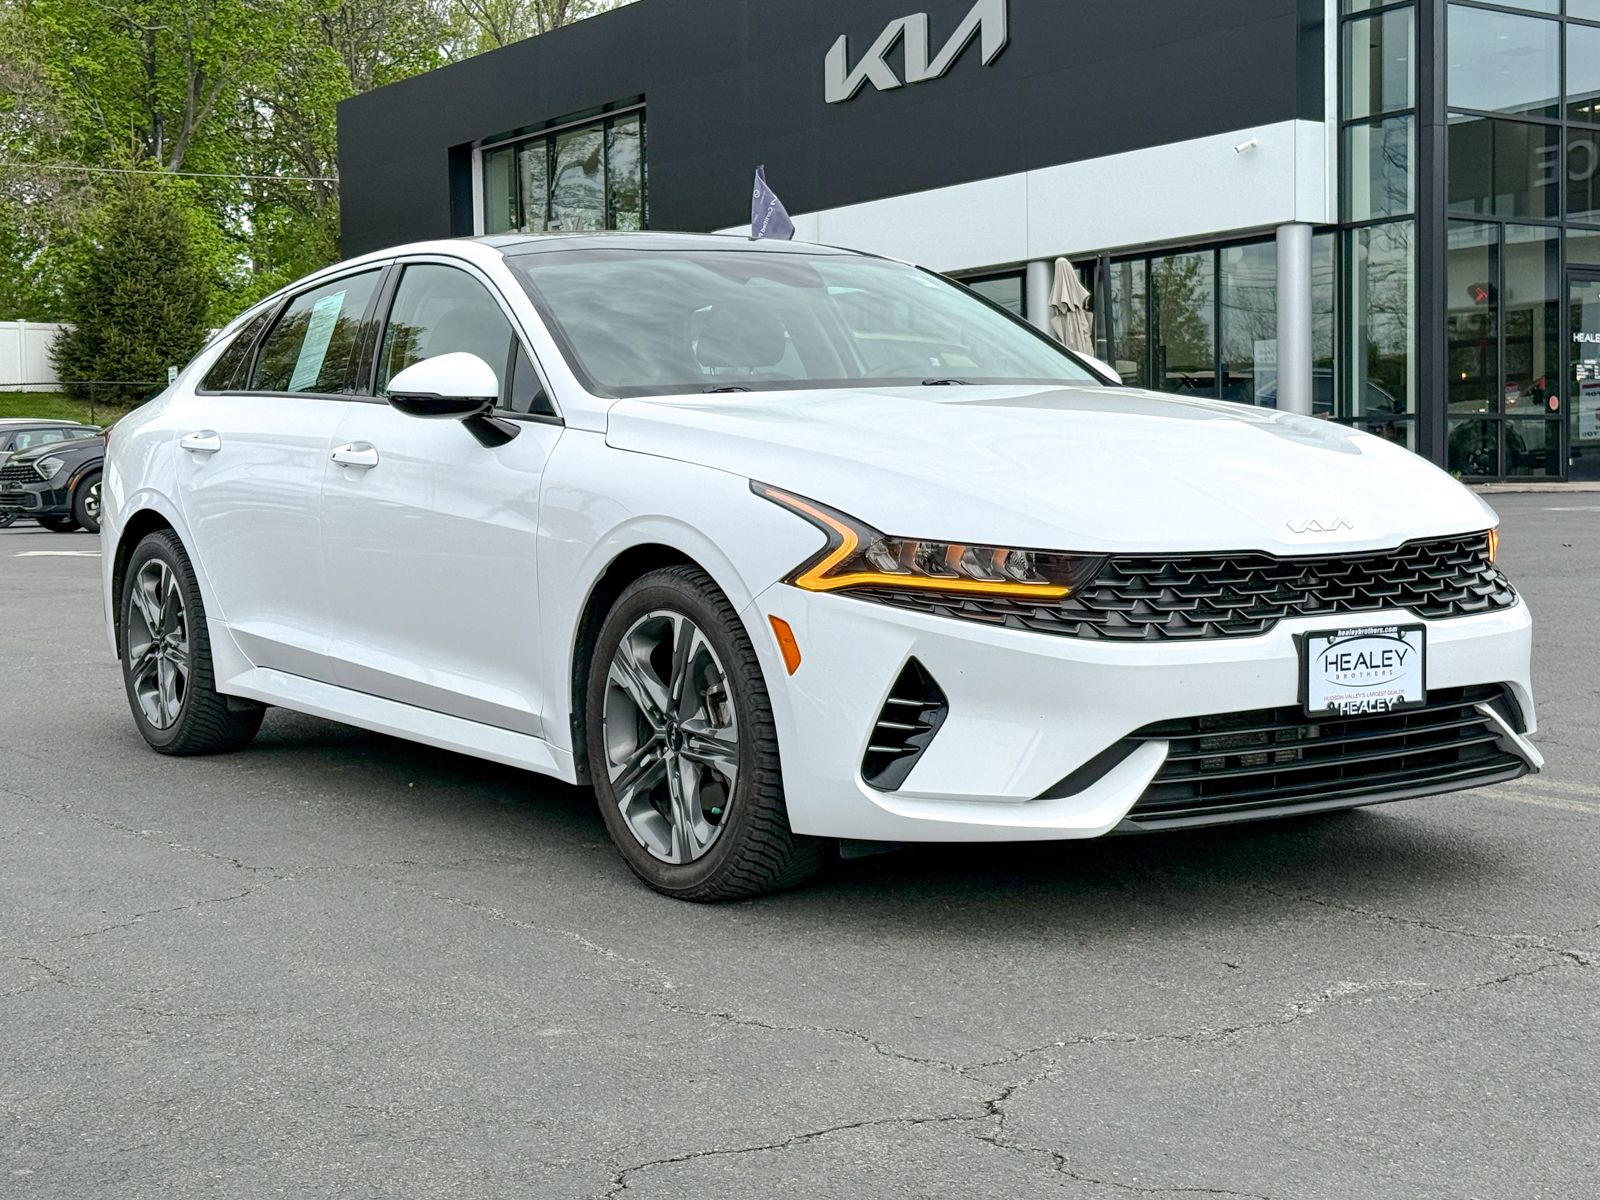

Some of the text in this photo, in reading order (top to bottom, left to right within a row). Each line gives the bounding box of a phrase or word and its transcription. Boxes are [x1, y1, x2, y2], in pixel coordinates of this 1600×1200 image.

[825, 0, 1007, 103] KIA
[1338, 626, 1398, 636] healeybrothers.com
[1325, 648, 1408, 672] HEALEY
[1336, 670, 1393, 680] BROTHERS
[1324, 694, 1344, 702] HUDSON
[1345, 692, 1366, 700] VALLEY'S
[1366, 690, 1387, 698] LARGEST
[1339, 698, 1394, 716] HEALEY
